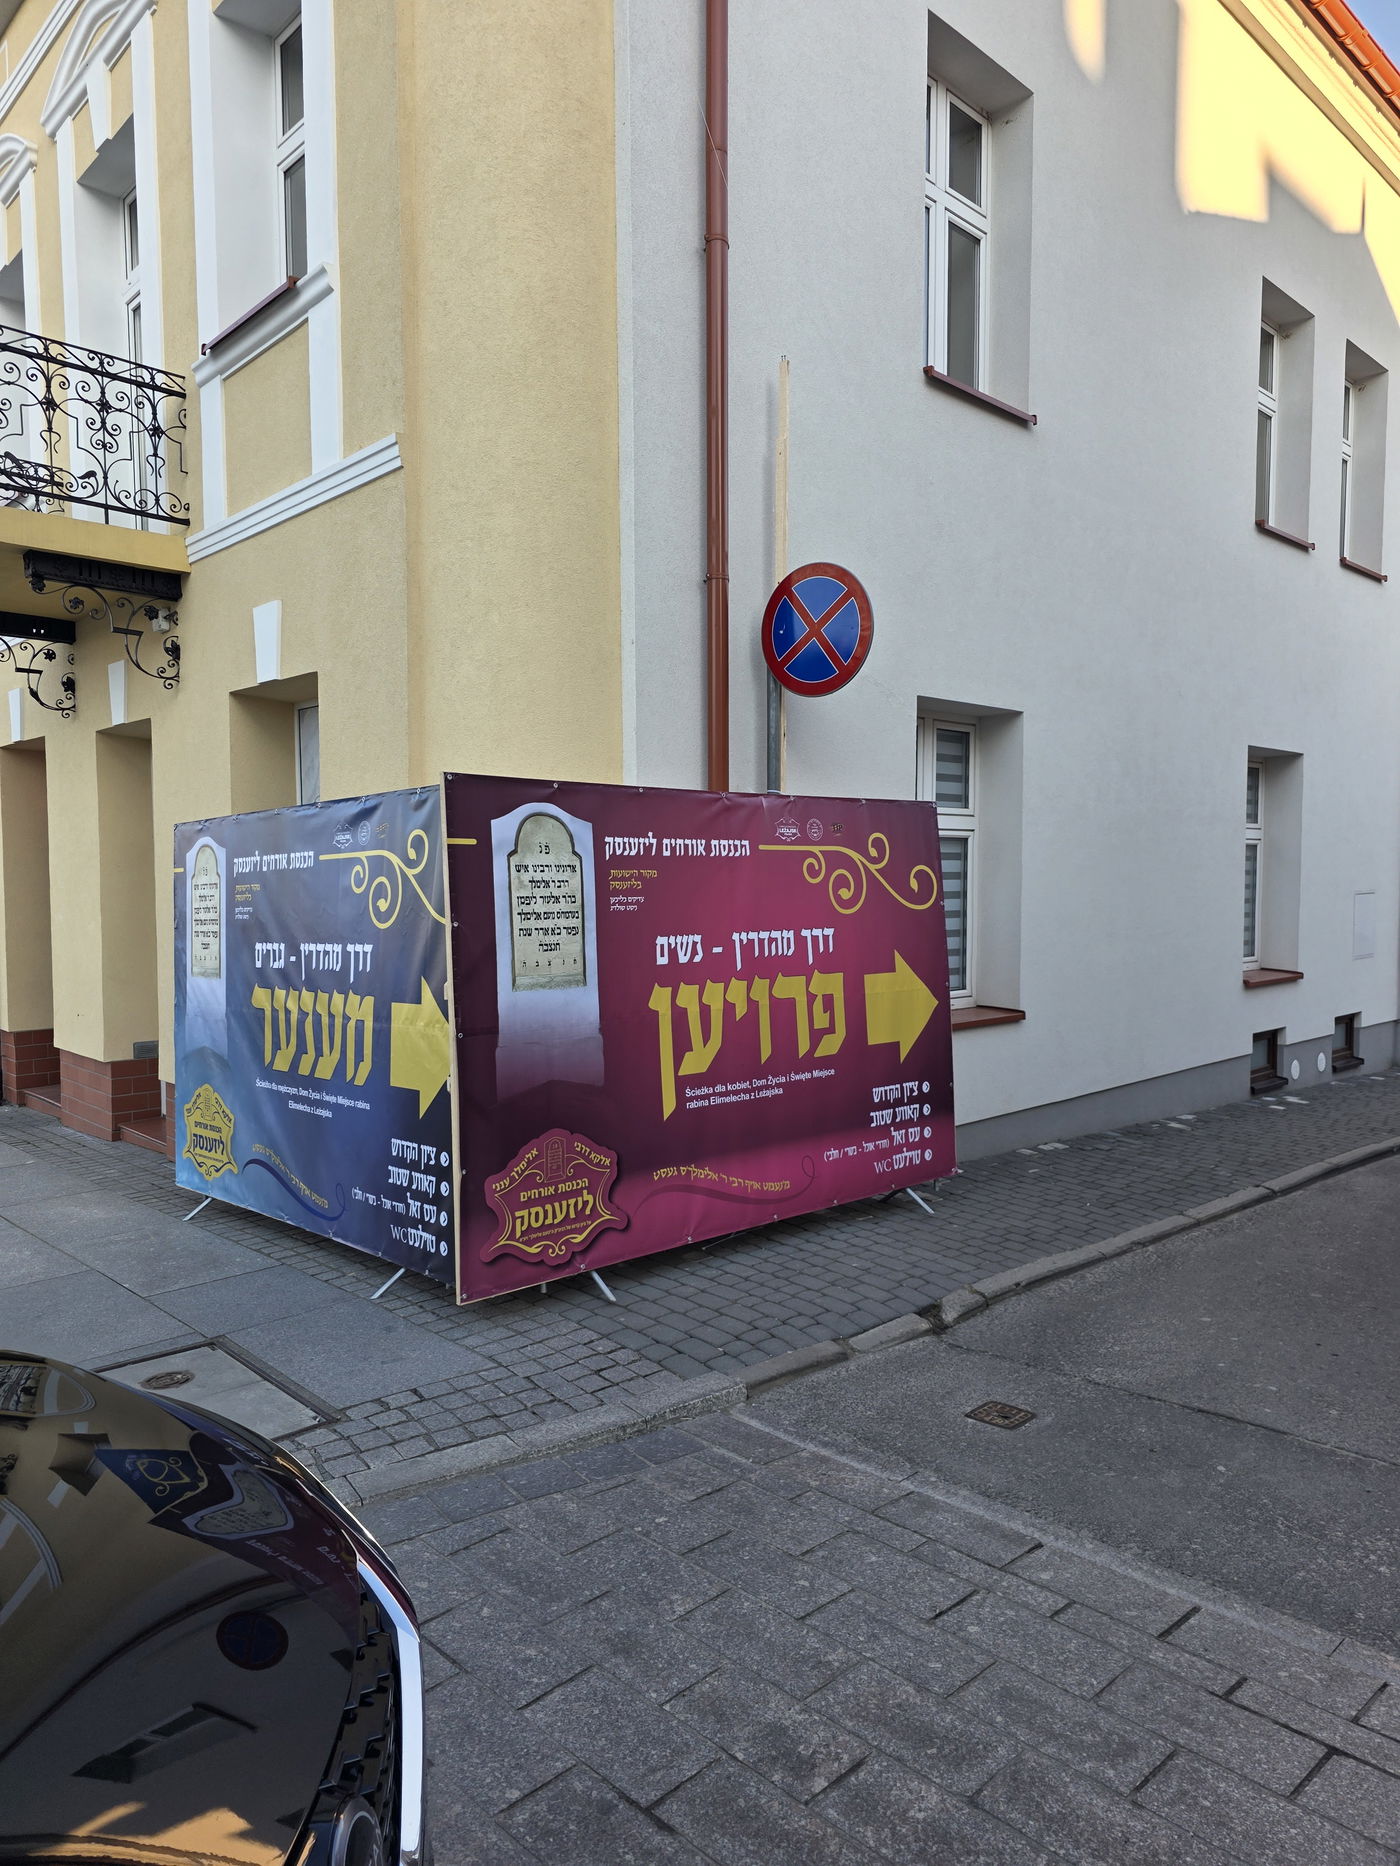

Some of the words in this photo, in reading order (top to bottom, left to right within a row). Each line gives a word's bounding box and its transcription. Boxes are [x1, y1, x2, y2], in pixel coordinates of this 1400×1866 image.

[604, 832, 658, 860] ליזענסק
[662, 837, 706, 856] אורחים
[710, 838, 750, 856] הכנסת
[234, 850, 261, 878] ליזענסק
[263, 853, 287, 872] אורחים
[290, 850, 314, 869] הכנסת
[255, 942, 285, 968] גברים
[656, 934, 704, 966] נשים
[732, 928, 795, 972] מהדרין
[800, 926, 835, 966] דרך
[300, 942, 342, 981] מהדרין
[346, 942, 373, 984] דרך
[251, 982, 375, 1086] מענער
[648, 968, 846, 1122] פרויען
[685, 1086, 713, 1098] Ścieżka
[714, 1083, 726, 1092] dla
[727, 1080, 752, 1092] kobiet,
[752, 1078, 767, 1088] Dom
[768, 1075, 786, 1087] Życia
[790, 1070, 812, 1082] Święte
[812, 1068, 835, 1078] Miejsce
[872, 1084, 901, 1103] הקדוש
[903, 1081, 919, 1102] ציון
[299, 1088, 308, 1097] Dom
[355, 1100, 370, 1110] rabina
[686, 1099, 709, 1109] rabina
[710, 1093, 750, 1106] Elimelecha
[755, 1087, 783, 1099] Leżajska
[870, 1108, 893, 1127] שטוב
[193, 1133, 225, 1156] ליזענסק
[890, 1127, 906, 1146] זאל
[391, 1138, 418, 1164] הקדוש
[421, 1144, 436, 1170] ציון
[510, 1148, 539, 1180] אלימלך
[874, 1159, 892, 1174] WC
[388, 1165, 410, 1187] שטוב
[558, 1178, 588, 1193] הכנסת
[729, 1176, 744, 1187] רבי
[407, 1192, 421, 1219] זאל
[520, 1186, 555, 1202] אורחים
[514, 1190, 594, 1240] ליזענסק
[390, 1224, 407, 1243] WC
